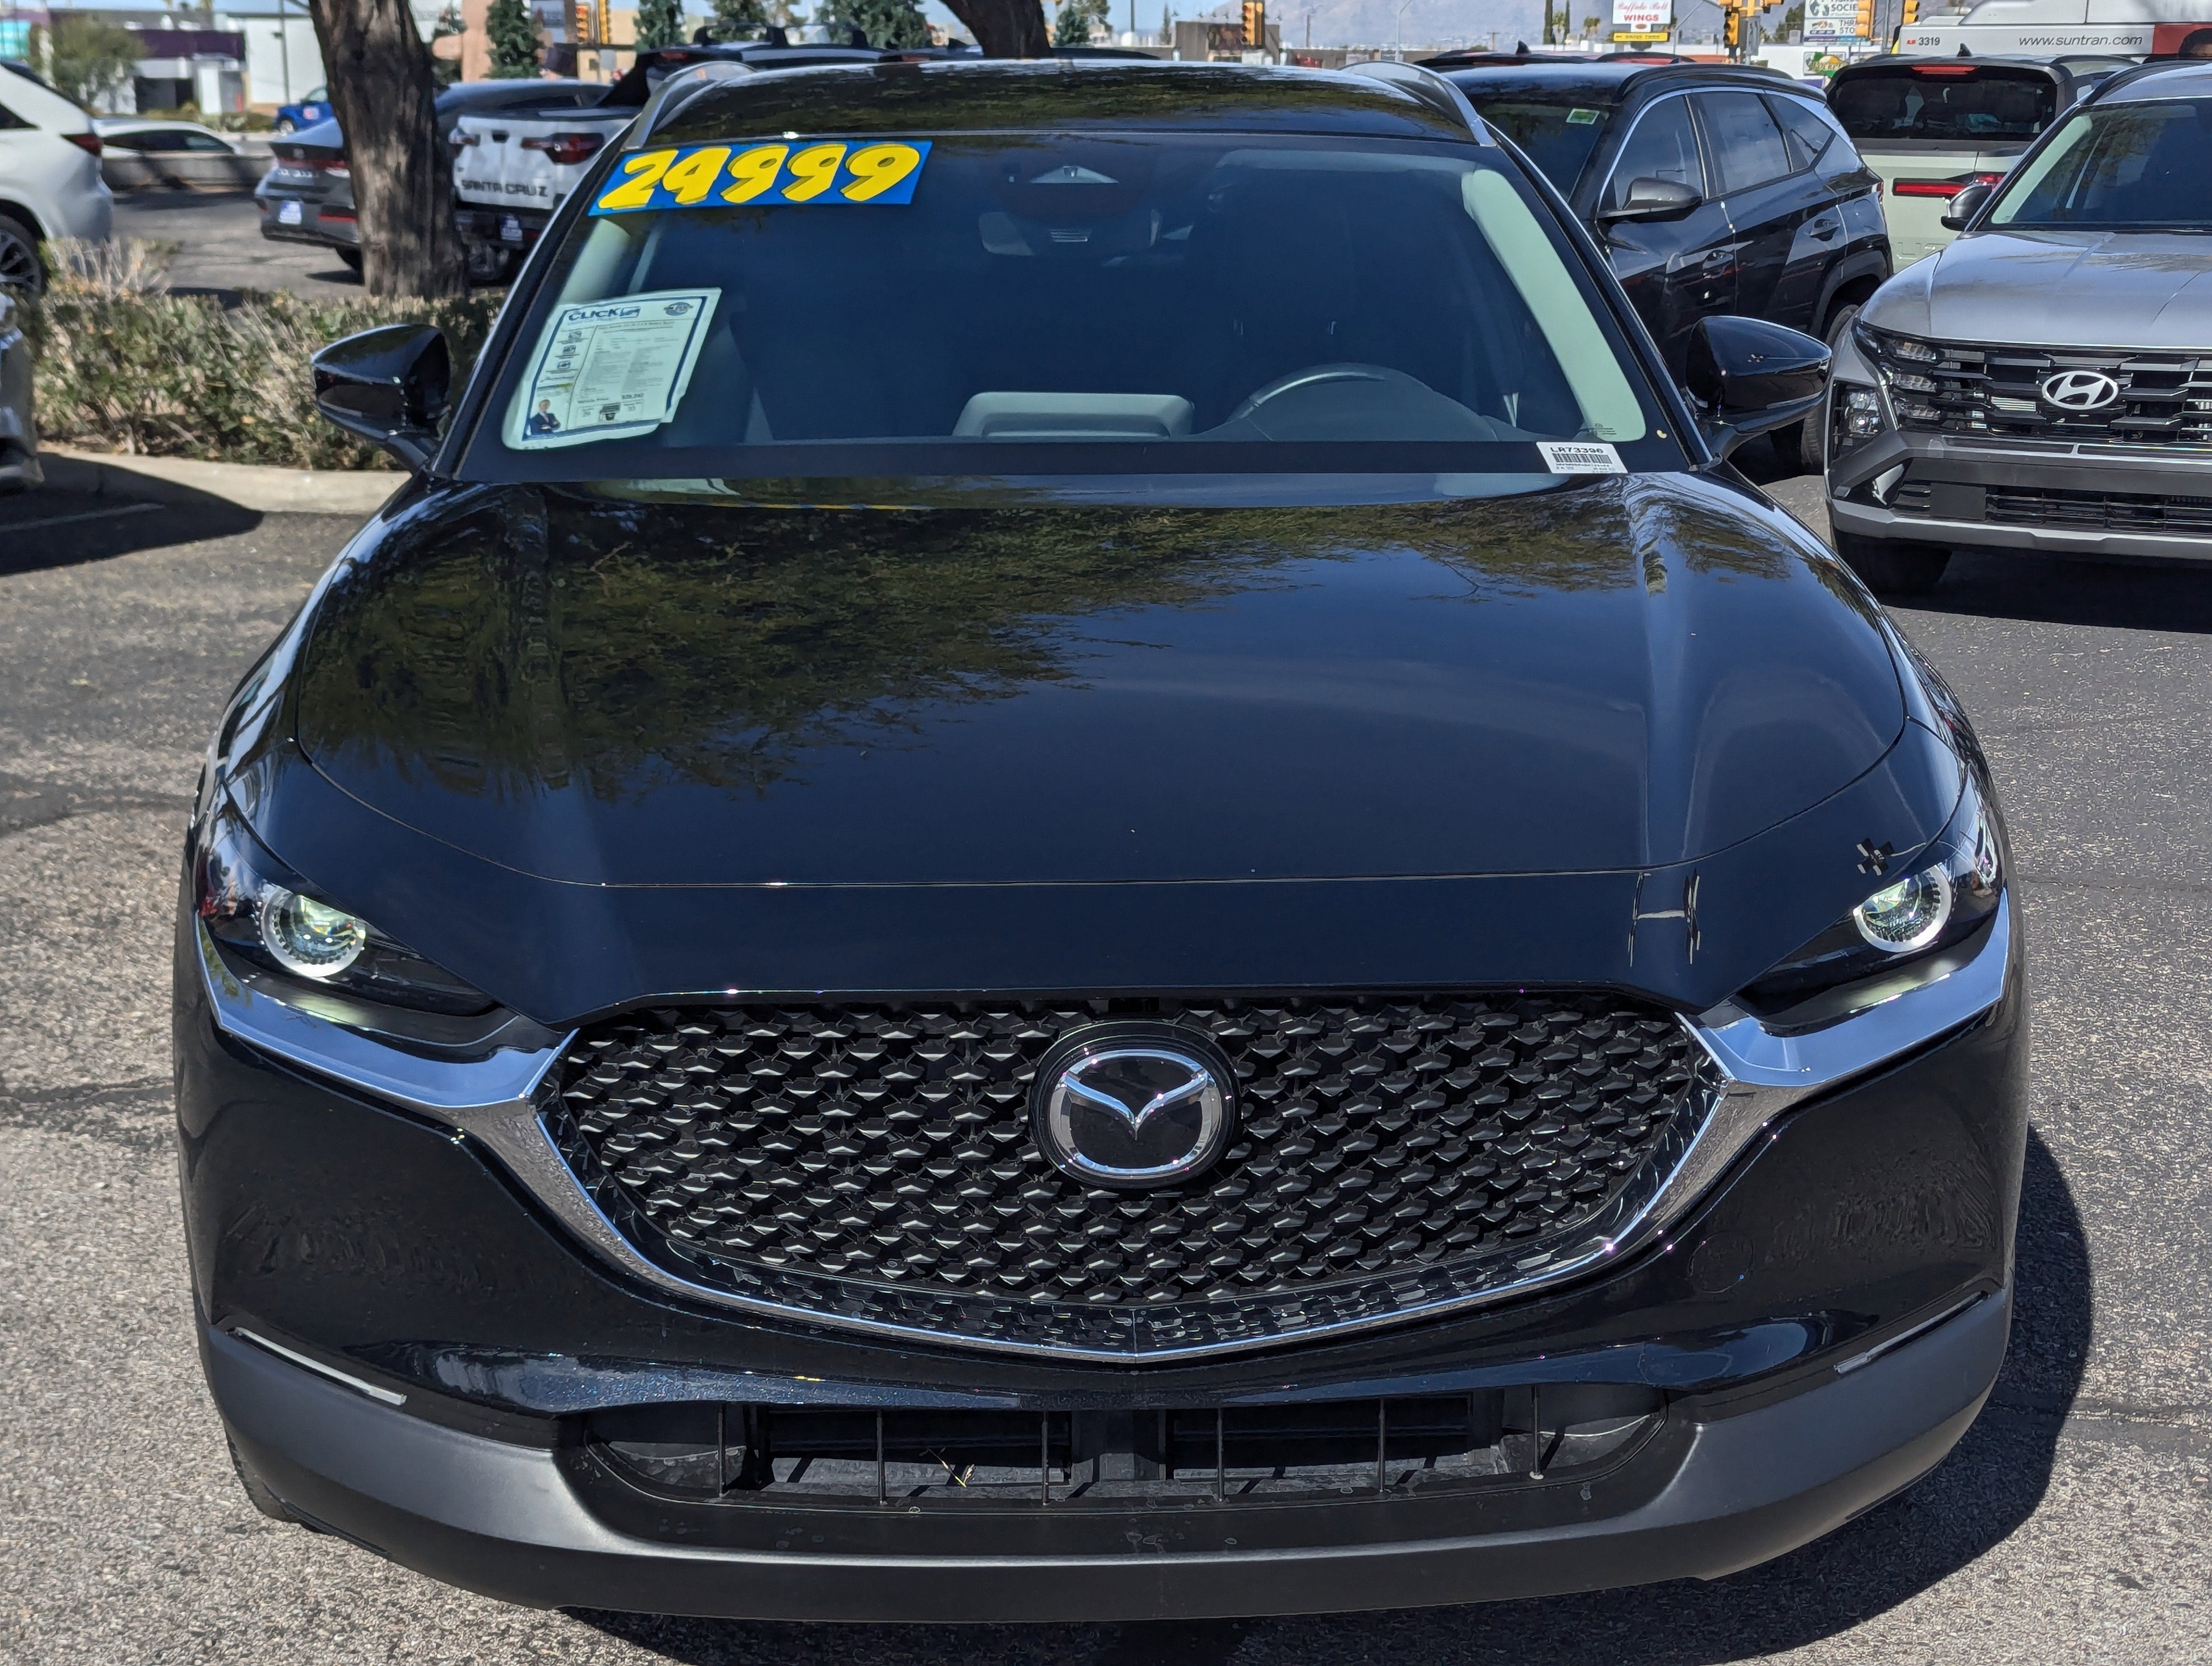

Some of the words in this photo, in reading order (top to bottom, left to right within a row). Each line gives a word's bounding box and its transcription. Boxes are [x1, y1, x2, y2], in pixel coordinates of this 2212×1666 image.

[1918, 37, 1940, 46] 3319
[2018, 34, 2143, 46] www.suntran.com
[598, 144, 920, 209] 24999
[461, 180, 503, 193] SANTA
[505, 183, 548, 197] CRUZ
[569, 307, 622, 321] CLICK
